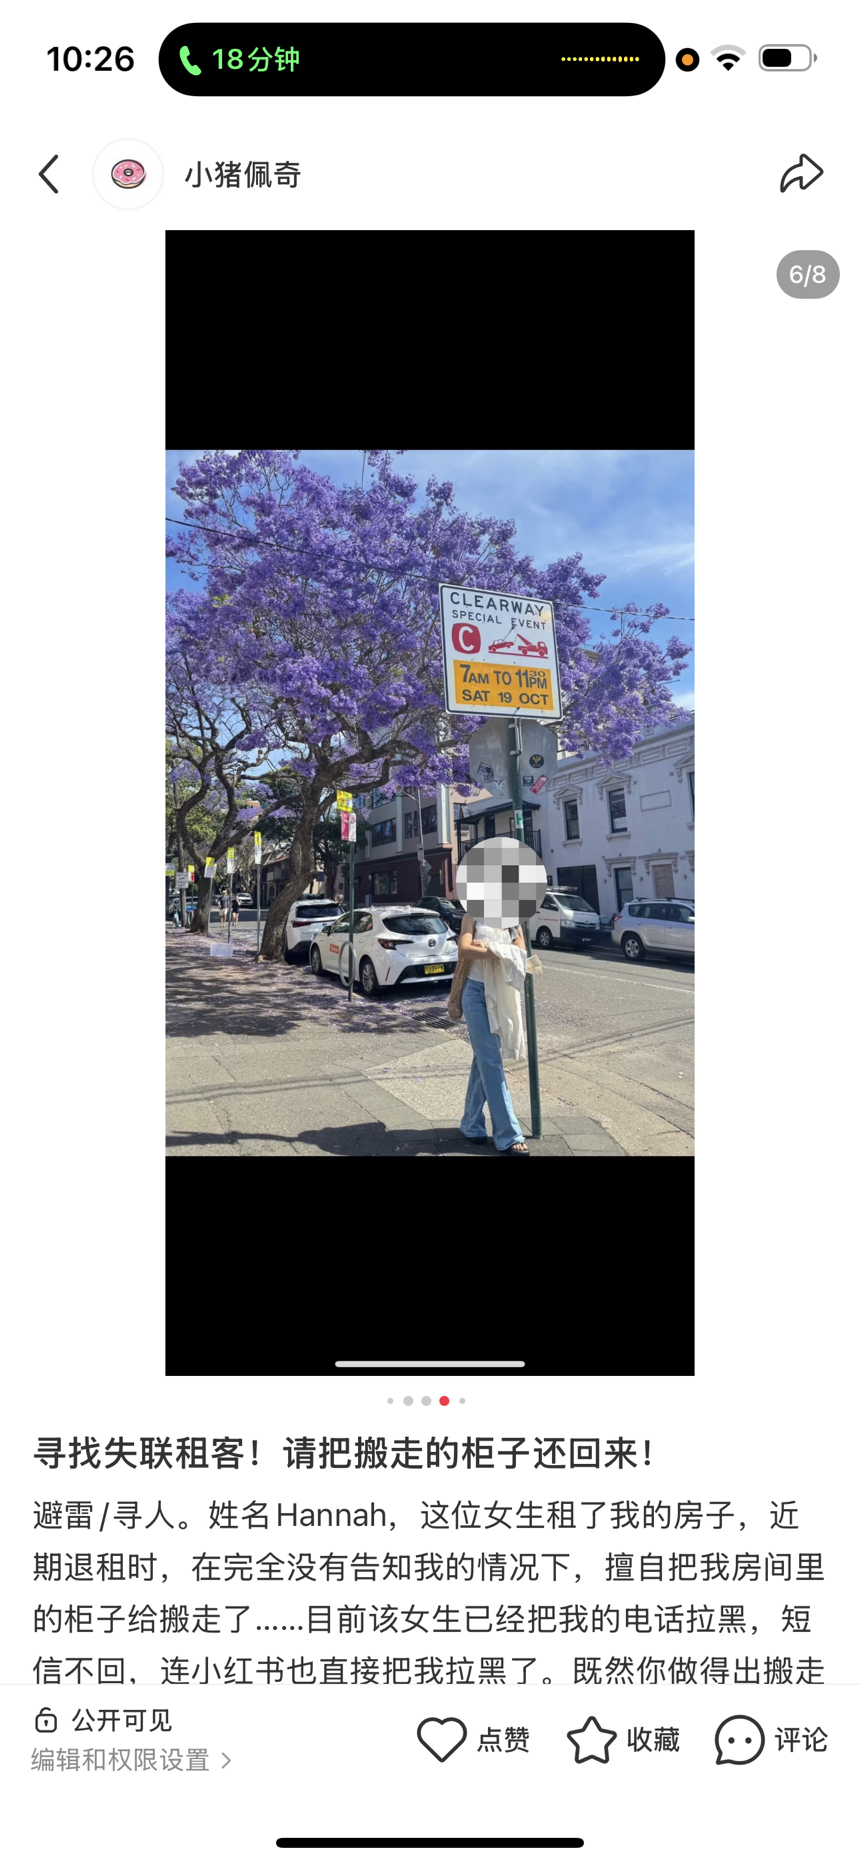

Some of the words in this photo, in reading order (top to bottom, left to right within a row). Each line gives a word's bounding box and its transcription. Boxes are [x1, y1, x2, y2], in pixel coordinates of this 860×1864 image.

[47, 46, 135, 71] 10:26
[212, 46, 300, 72] 18分钟
[184, 160, 301, 189] 小猪佩奇
[789, 265, 826, 288] 6/8
[450, 591, 544, 617] CLEARWAY
[452, 610, 502, 625] SPECIAL
[511, 617, 546, 630] EVENT
[458, 626, 474, 651] C
[460, 664, 489, 684] 7AM
[494, 670, 512, 685] TO
[462, 689, 490, 702] SAT
[498, 691, 512, 703] 19
[519, 693, 549, 705] OCT
[33, 1436, 651, 1470] 寻找失联租客！请把搬走的柜子还回来！
[33, 1551, 825, 1583] 期退租时，在完全没有告知我的情况下，擅自把我房间里
[71, 1708, 172, 1732] 公开可见
[477, 1726, 530, 1753] 点赞
[627, 1726, 680, 1753] 收藏
[774, 1726, 828, 1753] 评论
[30, 1747, 210, 1772] 编辑和权限设置
